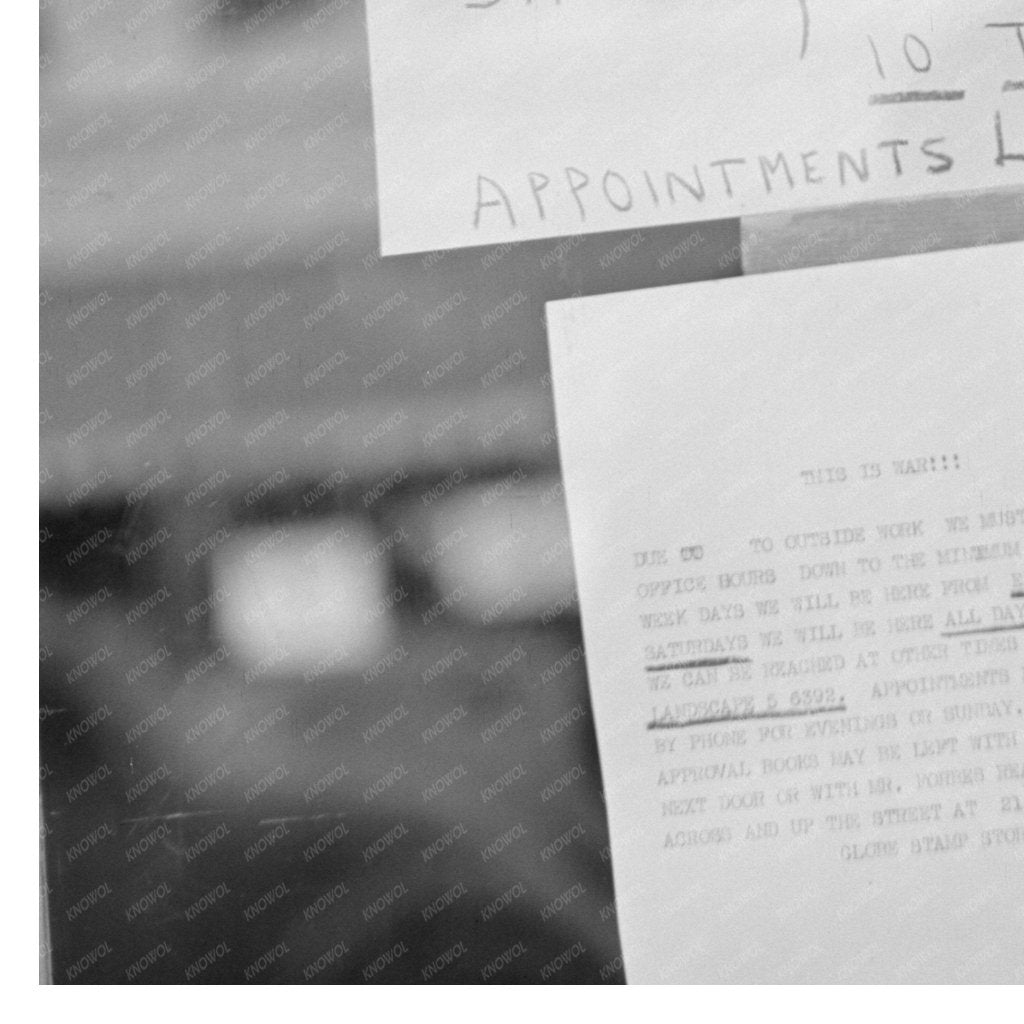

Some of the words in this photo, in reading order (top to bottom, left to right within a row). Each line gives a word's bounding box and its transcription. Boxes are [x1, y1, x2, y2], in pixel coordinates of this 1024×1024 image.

[868, 33, 933, 81] 10
[473, 136, 956, 231] APPOINTMENTS
[800, 465, 847, 486] THIS
[859, 461, 882, 481] IS
[749, 536, 774, 555] TO
[784, 526, 866, 551] OUTSIDE
[875, 519, 925, 540] WORK
[945, 516, 970, 534] WE
[636, 573, 707, 599] OFFICE
[717, 567, 778, 590] HOURS
[799, 559, 848, 581] DOWN
[857, 556, 882, 575] TO
[891, 551, 926, 572] THE
[638, 608, 687, 630] WEEK
[698, 602, 746, 624] DAYS
[755, 599, 780, 617] WE
[790, 592, 840, 613] WILL
[849, 588, 873, 607] BE
[885, 582, 932, 604] HERE
[643, 633, 750, 660] SATURDAYS
[759, 630, 784, 648] WE
[793, 623, 844, 645] WILL
[853, 619, 877, 638] BE
[886, 613, 934, 634] HERE
[945, 606, 983, 628] ALL
[648, 673, 673, 692] WE
[682, 668, 718, 689] CAN
[762, 653, 847, 679] REACHED
[854, 649, 881, 670] AT
[649, 696, 756, 724] LANDSCAPE
[767, 691, 779, 710] 5
[871, 668, 1012, 700] APPOINTMENTS
[654, 737, 677, 756] BY
[689, 727, 748, 751] PHONE
[803, 712, 900, 739] EVENINGS
[656, 759, 752, 788] APPROVAL
[762, 753, 820, 776] BOOKS
[830, 748, 866, 769] MAY
[876, 744, 901, 763] BE
[912, 736, 959, 760] LEFT
[969, 729, 1018, 753] WITH
[661, 796, 708, 819] NEXT
[718, 790, 766, 812] DOOR
[809, 779, 860, 803] WITH
[663, 825, 733, 850] ACROSS
[790, 816, 815, 836] UP
[825, 812, 861, 832] THE
[871, 802, 943, 827] STREET
[952, 799, 979, 820] AT
[909, 832, 970, 856] STAMP
